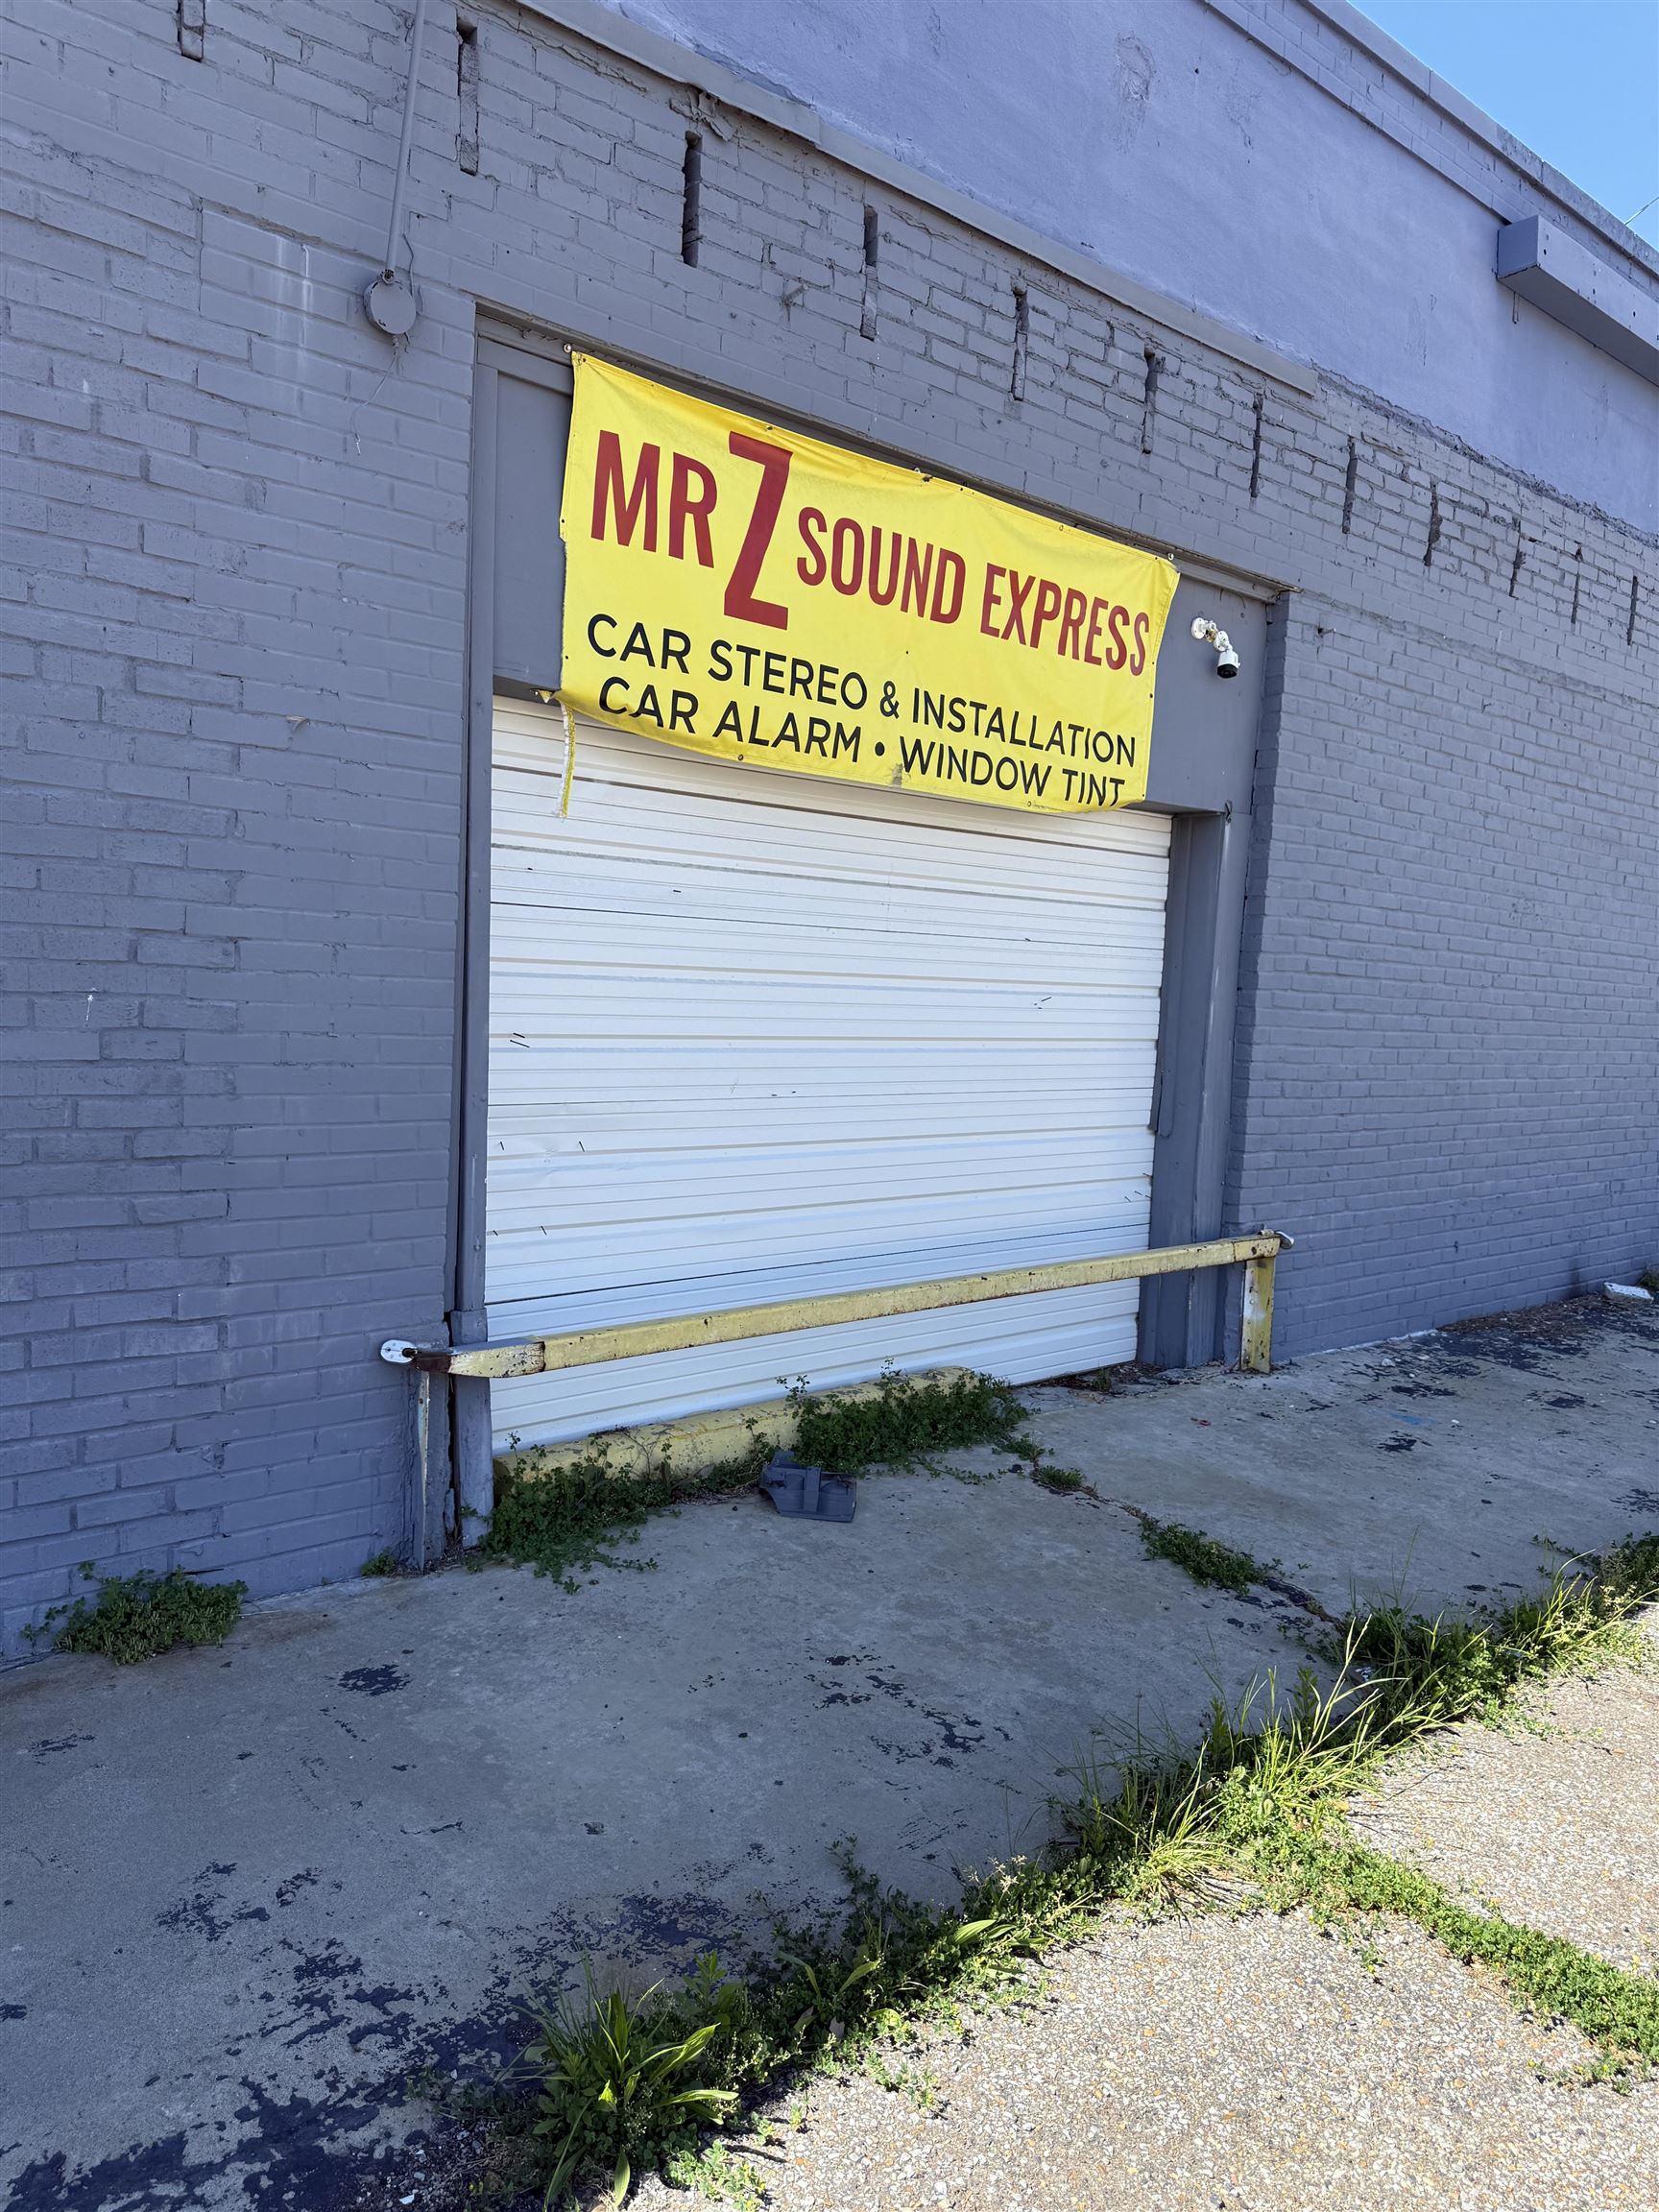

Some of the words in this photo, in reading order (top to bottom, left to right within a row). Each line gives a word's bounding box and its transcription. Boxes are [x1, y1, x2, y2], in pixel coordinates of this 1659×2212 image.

[590, 429, 717, 568] MR
[723, 430, 794, 631] Z
[797, 506, 966, 624] SOUND
[980, 563, 1150, 676] EXPRESS
[587, 613, 691, 676] CAR
[708, 638, 868, 711] STEREO
[879, 679, 901, 720] &
[912, 686, 1136, 769] INSTALLATION
[598, 675, 699, 735] CAR
[712, 699, 861, 764] ALARM
[900, 734, 1052, 797] WINDOW
[1062, 768, 1126, 808] TINT
